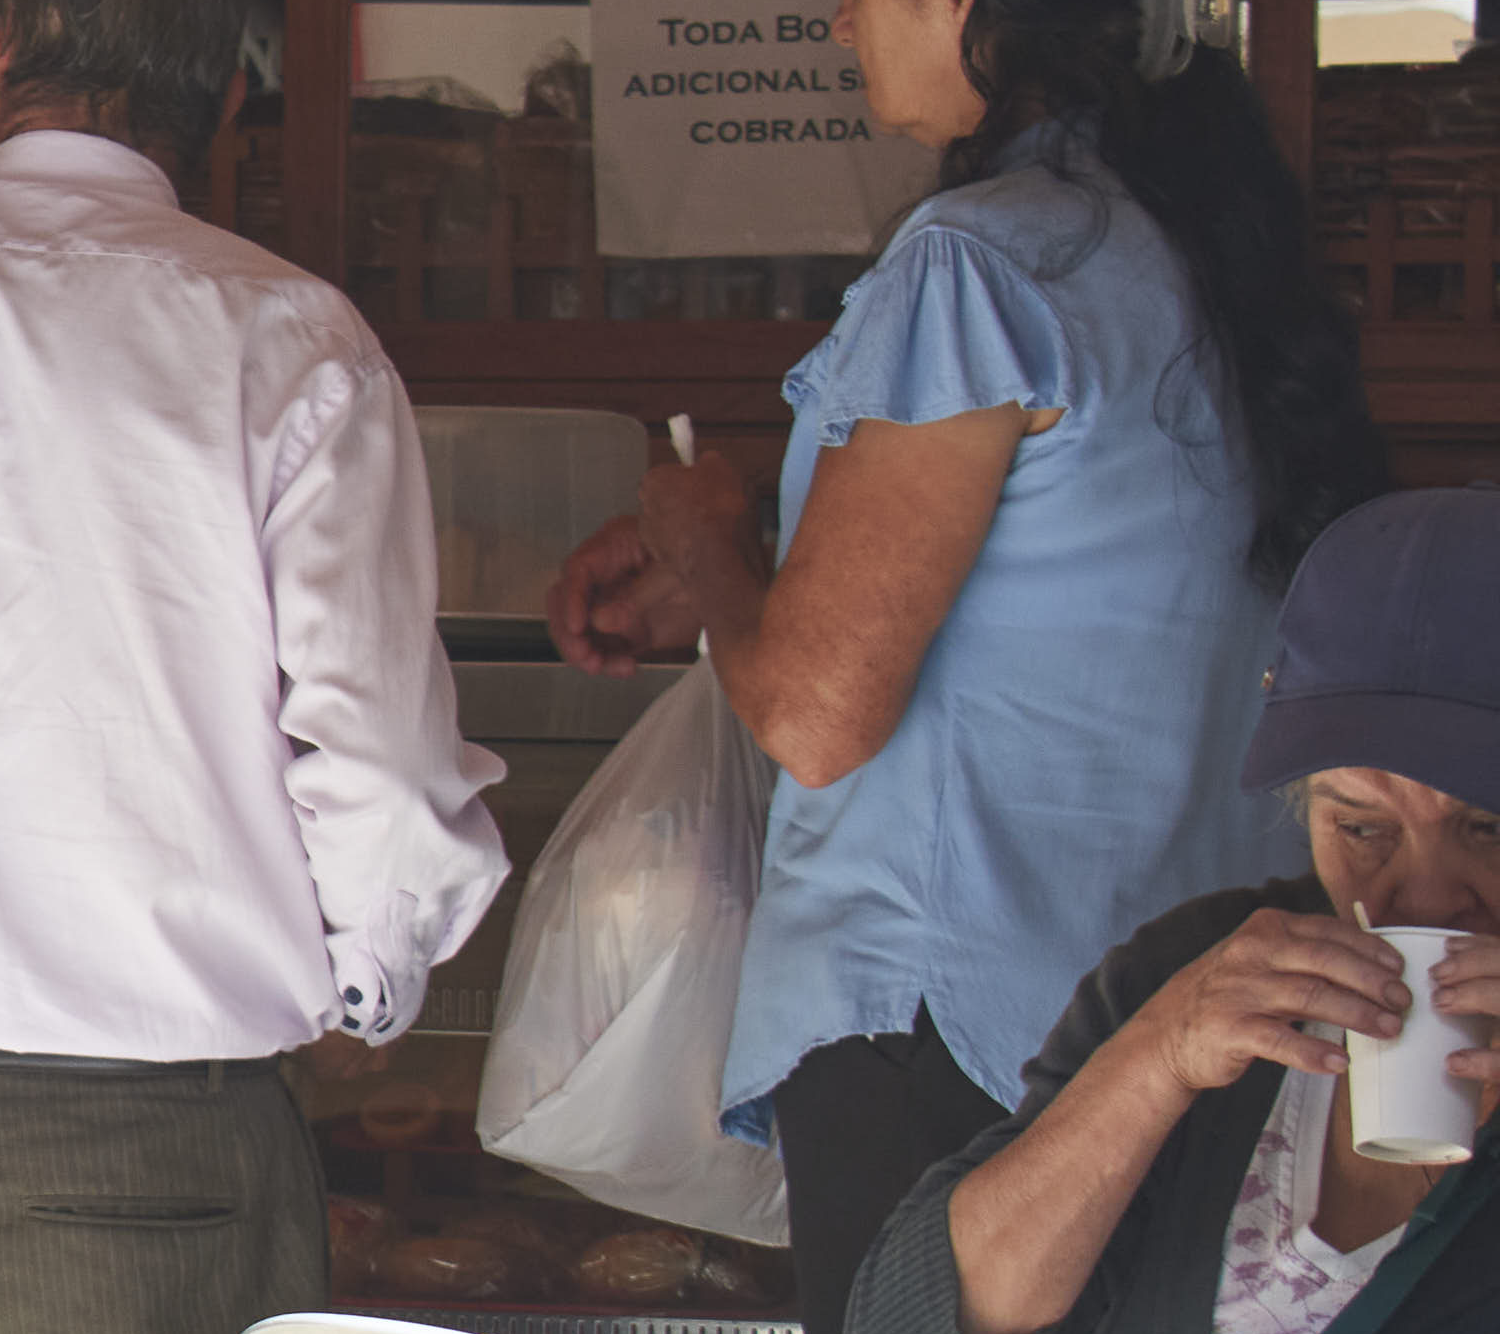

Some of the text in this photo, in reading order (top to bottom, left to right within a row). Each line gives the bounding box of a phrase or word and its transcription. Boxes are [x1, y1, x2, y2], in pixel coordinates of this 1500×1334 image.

[775, 14, 831, 44] BO
[623, 69, 864, 98] ADICIONAL S
[689, 117, 873, 145] COBRADA
